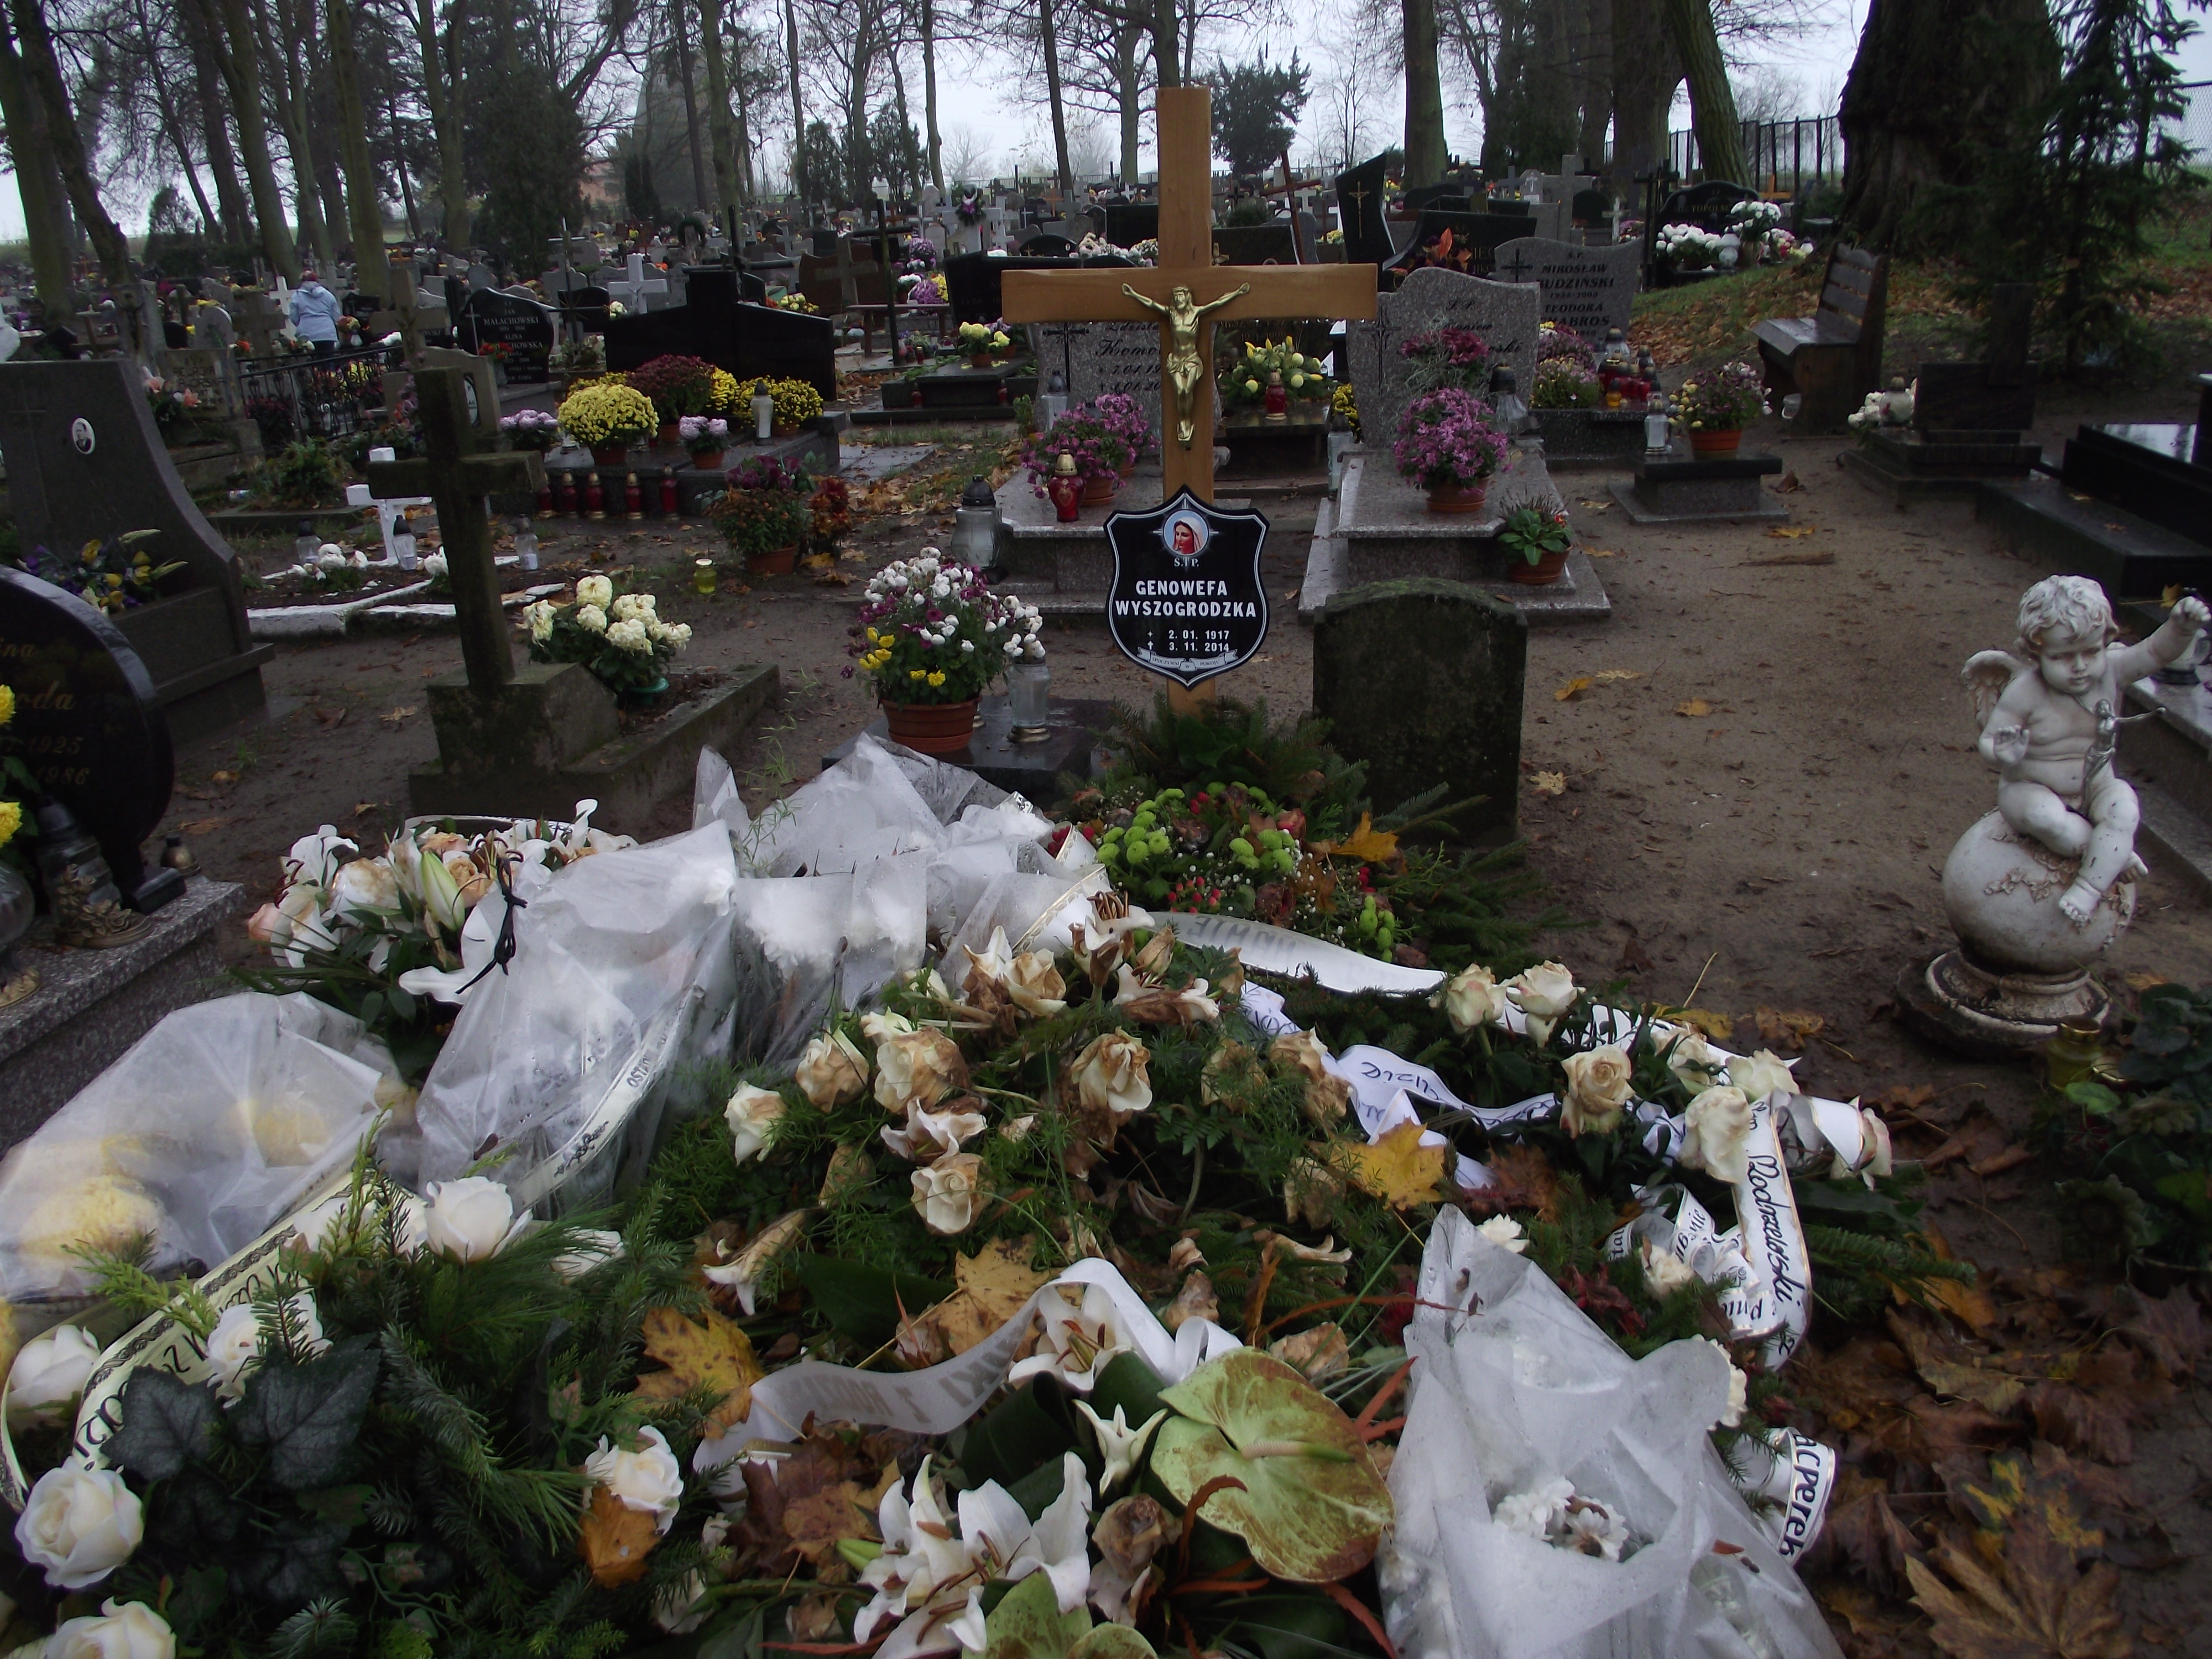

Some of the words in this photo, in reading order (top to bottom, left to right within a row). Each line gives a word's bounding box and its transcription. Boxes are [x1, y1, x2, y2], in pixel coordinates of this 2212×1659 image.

[1545, 302, 1603, 313] TEODORA
[1095, 338, 1161, 356] Komo
[1135, 580, 1228, 596] GENOWEFA
[1115, 600, 1257, 618] WYSZOGRODZKA
[1205, 630, 1230, 640] 1917
[1204, 642, 1230, 652] 2014
[1779, 1434, 1821, 1557] acperek
